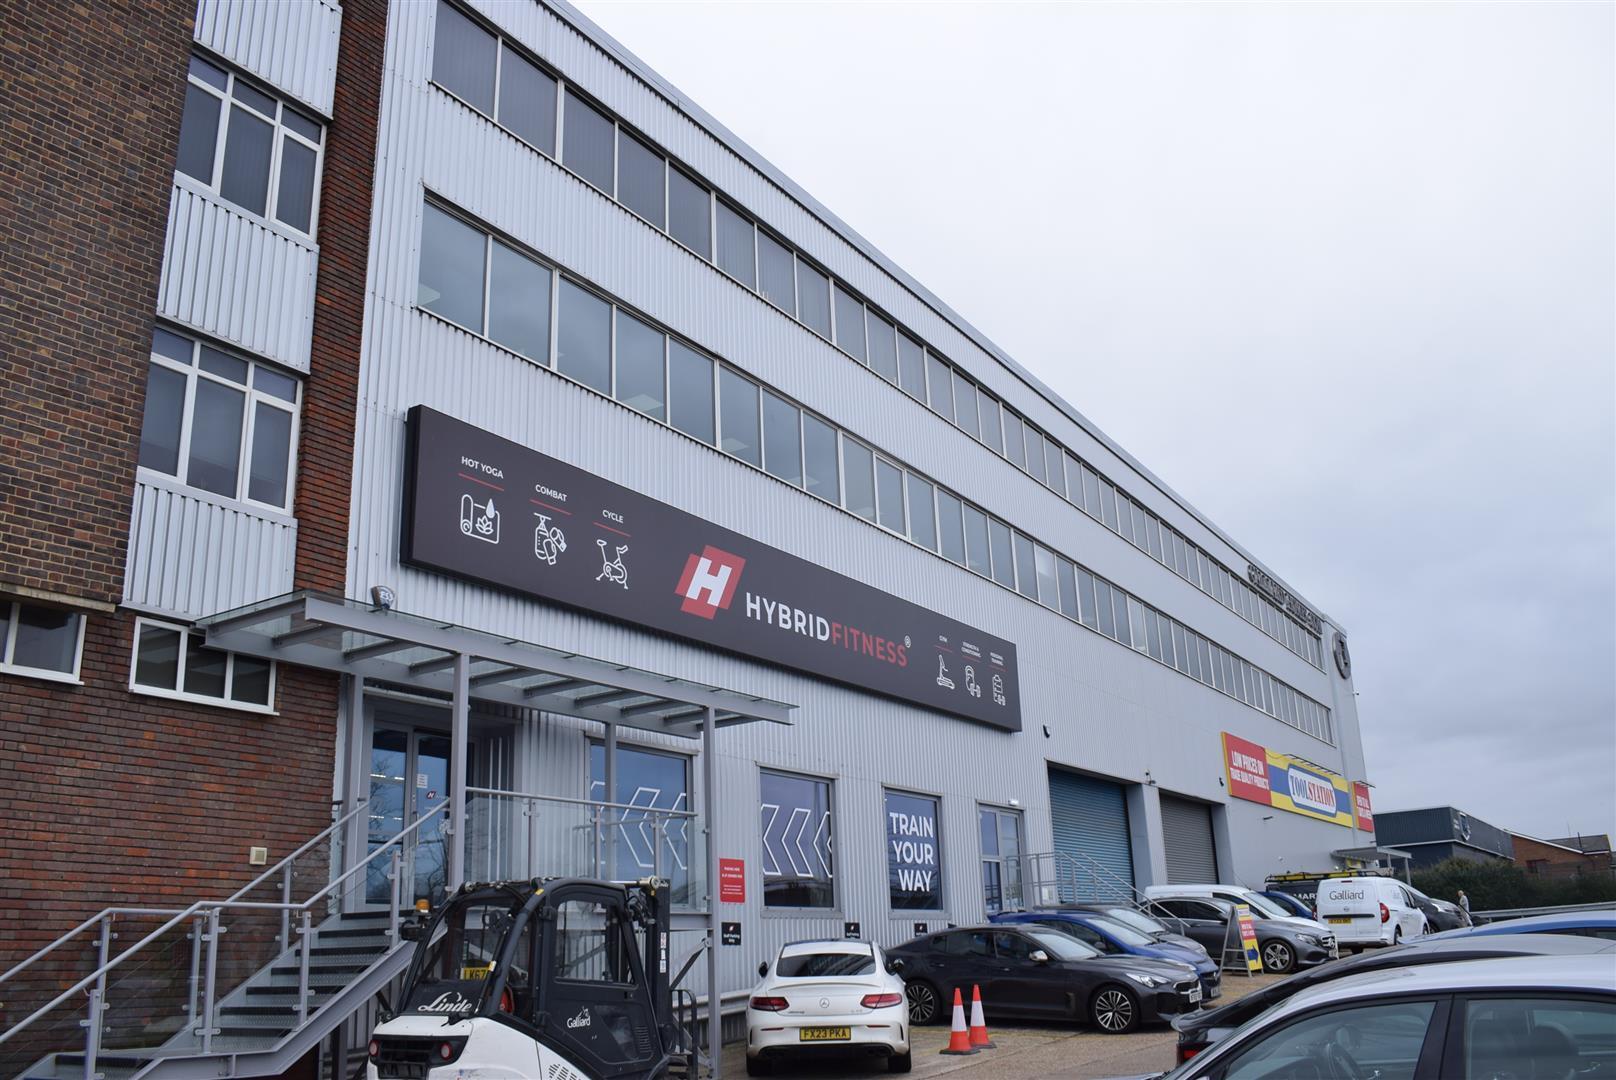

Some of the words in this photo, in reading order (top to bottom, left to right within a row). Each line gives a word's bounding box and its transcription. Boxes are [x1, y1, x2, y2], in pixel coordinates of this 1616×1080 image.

[461, 455, 479, 469] HOT
[480, 463, 504, 479] YOGA
[535, 484, 567, 502] COMBAT
[602, 509, 624, 524] CYCLE
[1290, 775, 1335, 807] TOOLSTATION
[889, 812, 934, 838] TRAIN
[892, 840, 934, 865] YOUR
[898, 869, 932, 892] WAY
[1329, 890, 1364, 901] Galliard
[418, 991, 472, 1013] Linde
[567, 1015, 591, 1029] Galliard
[803, 1028, 827, 1039] FX23
[829, 1027, 847, 1038] PKA
